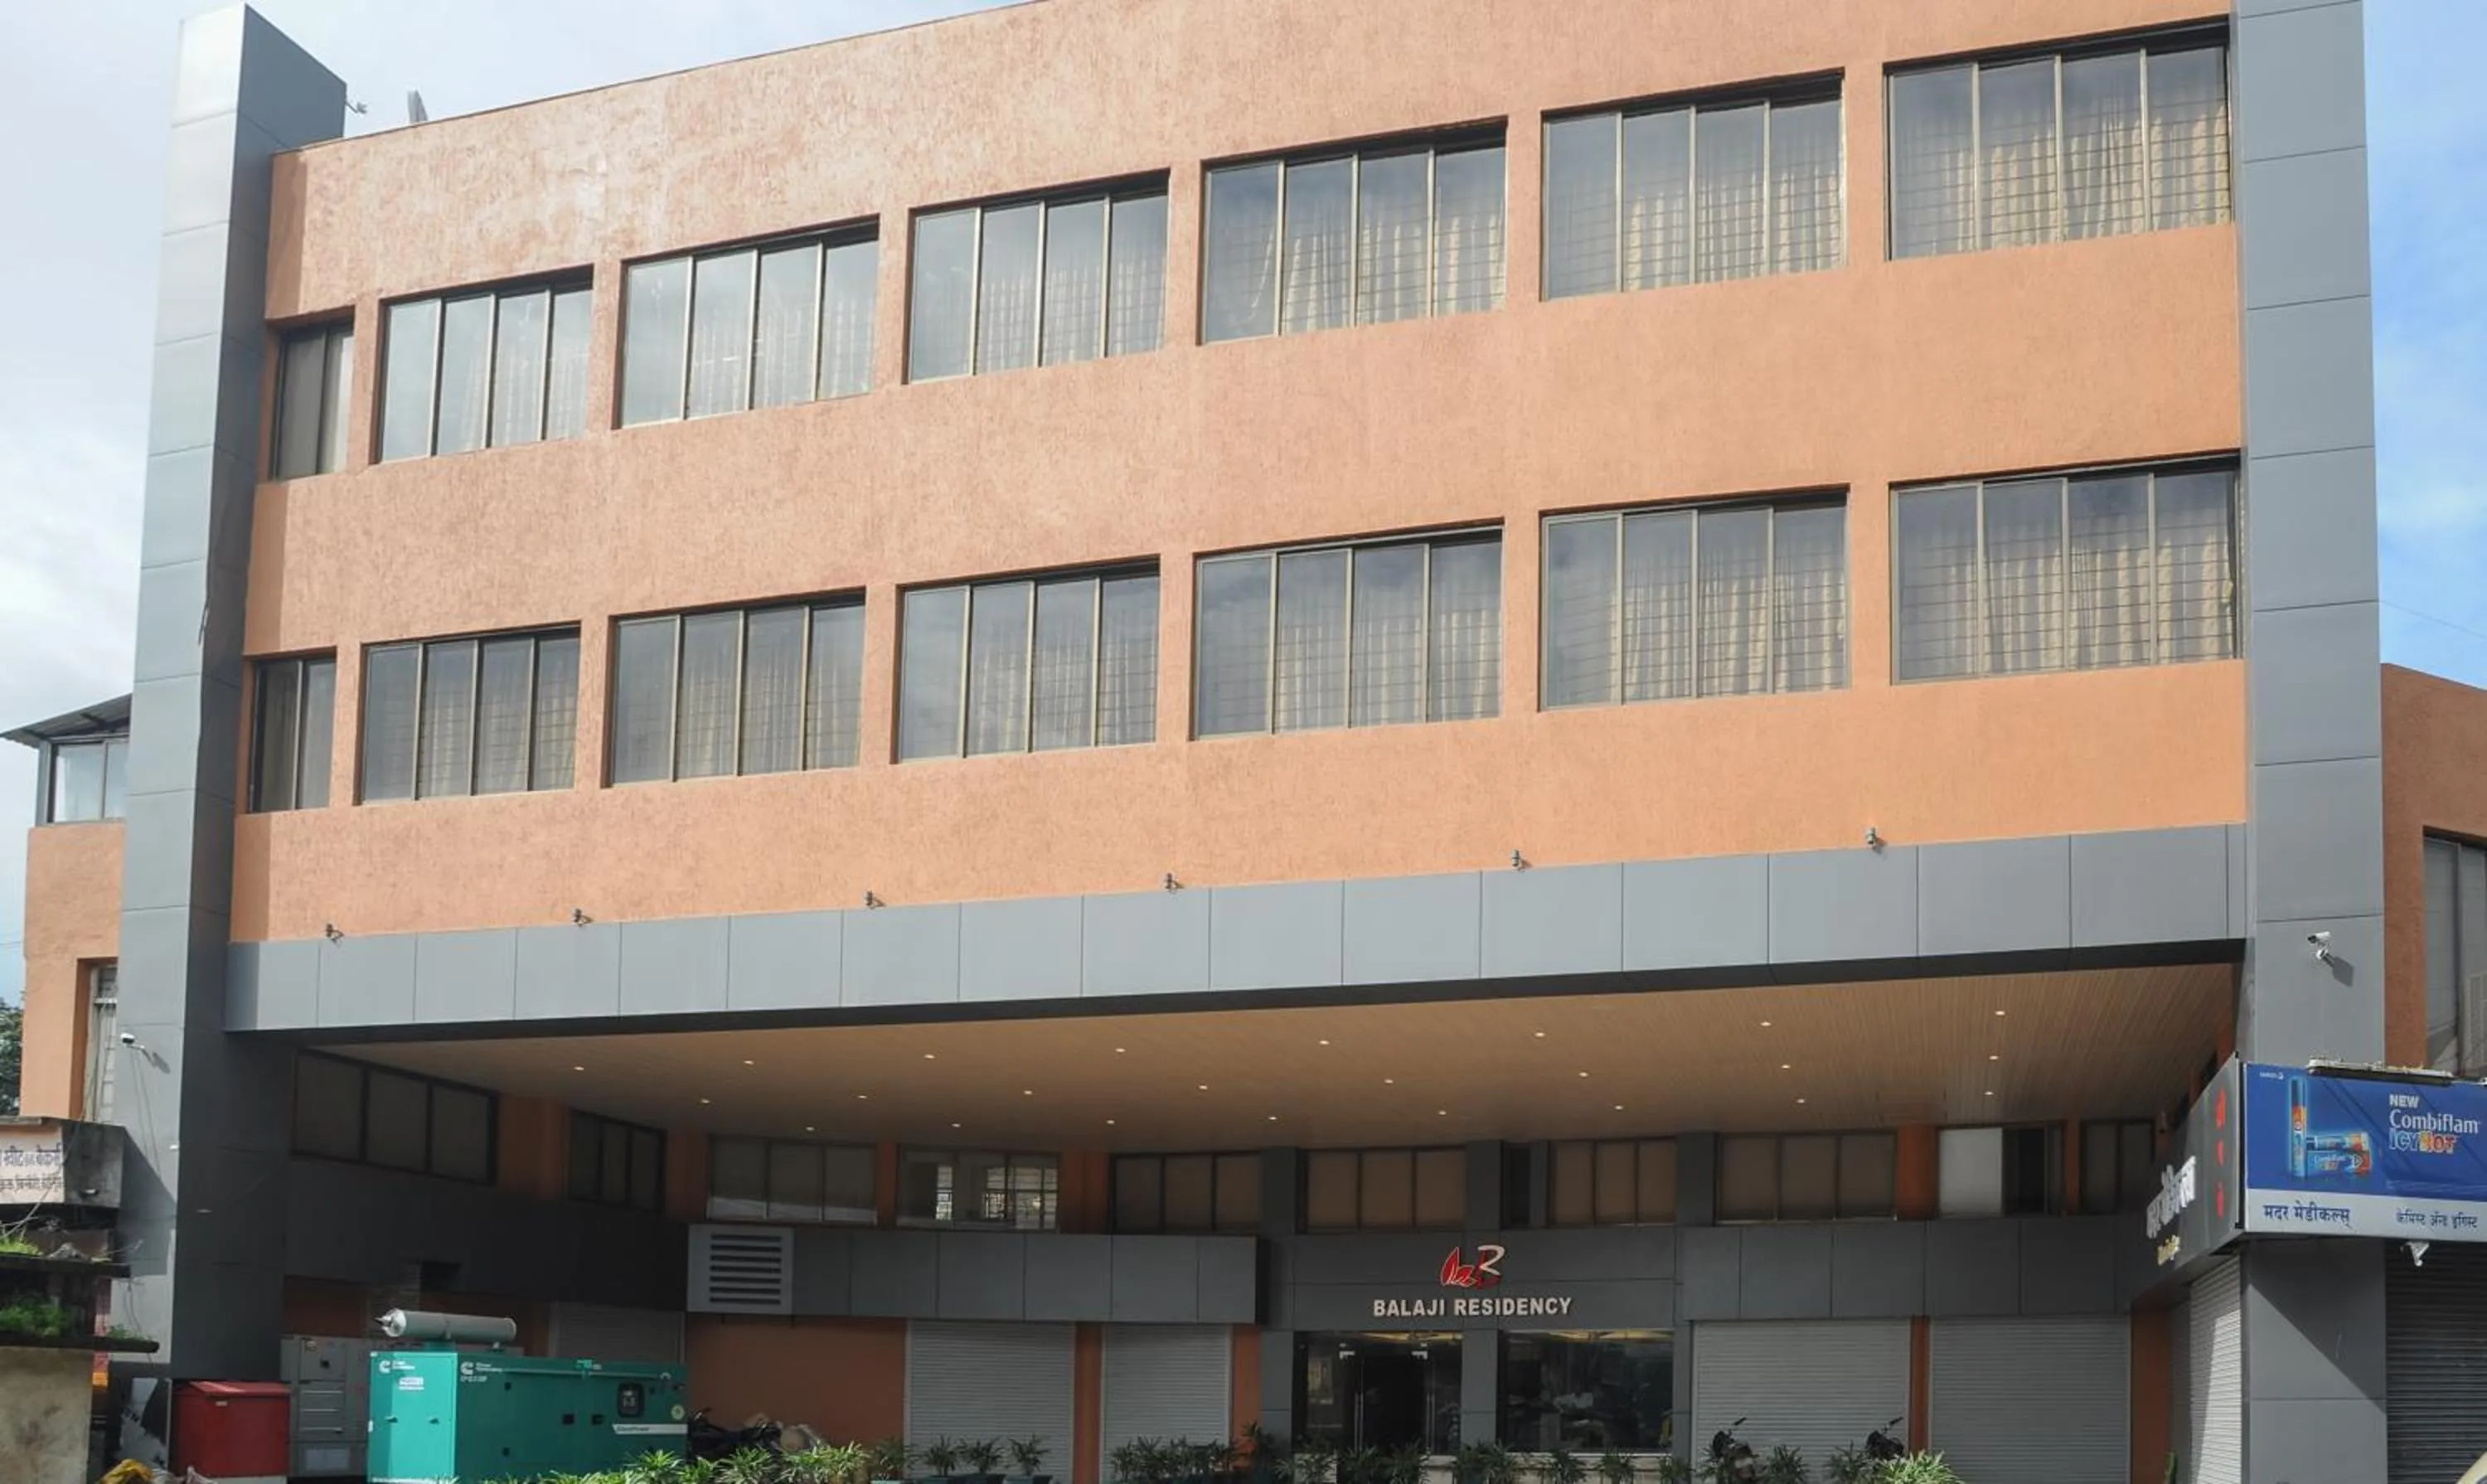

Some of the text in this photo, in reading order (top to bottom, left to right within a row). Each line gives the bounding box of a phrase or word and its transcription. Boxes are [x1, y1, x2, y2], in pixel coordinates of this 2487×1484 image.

[2388, 1094, 2420, 1108] NEW
[2388, 1108, 2478, 1134] Combiflam
[2262, 1205, 2290, 1222] मदर
[1373, 1297, 1573, 1317] BALAJI RESIDENCY
